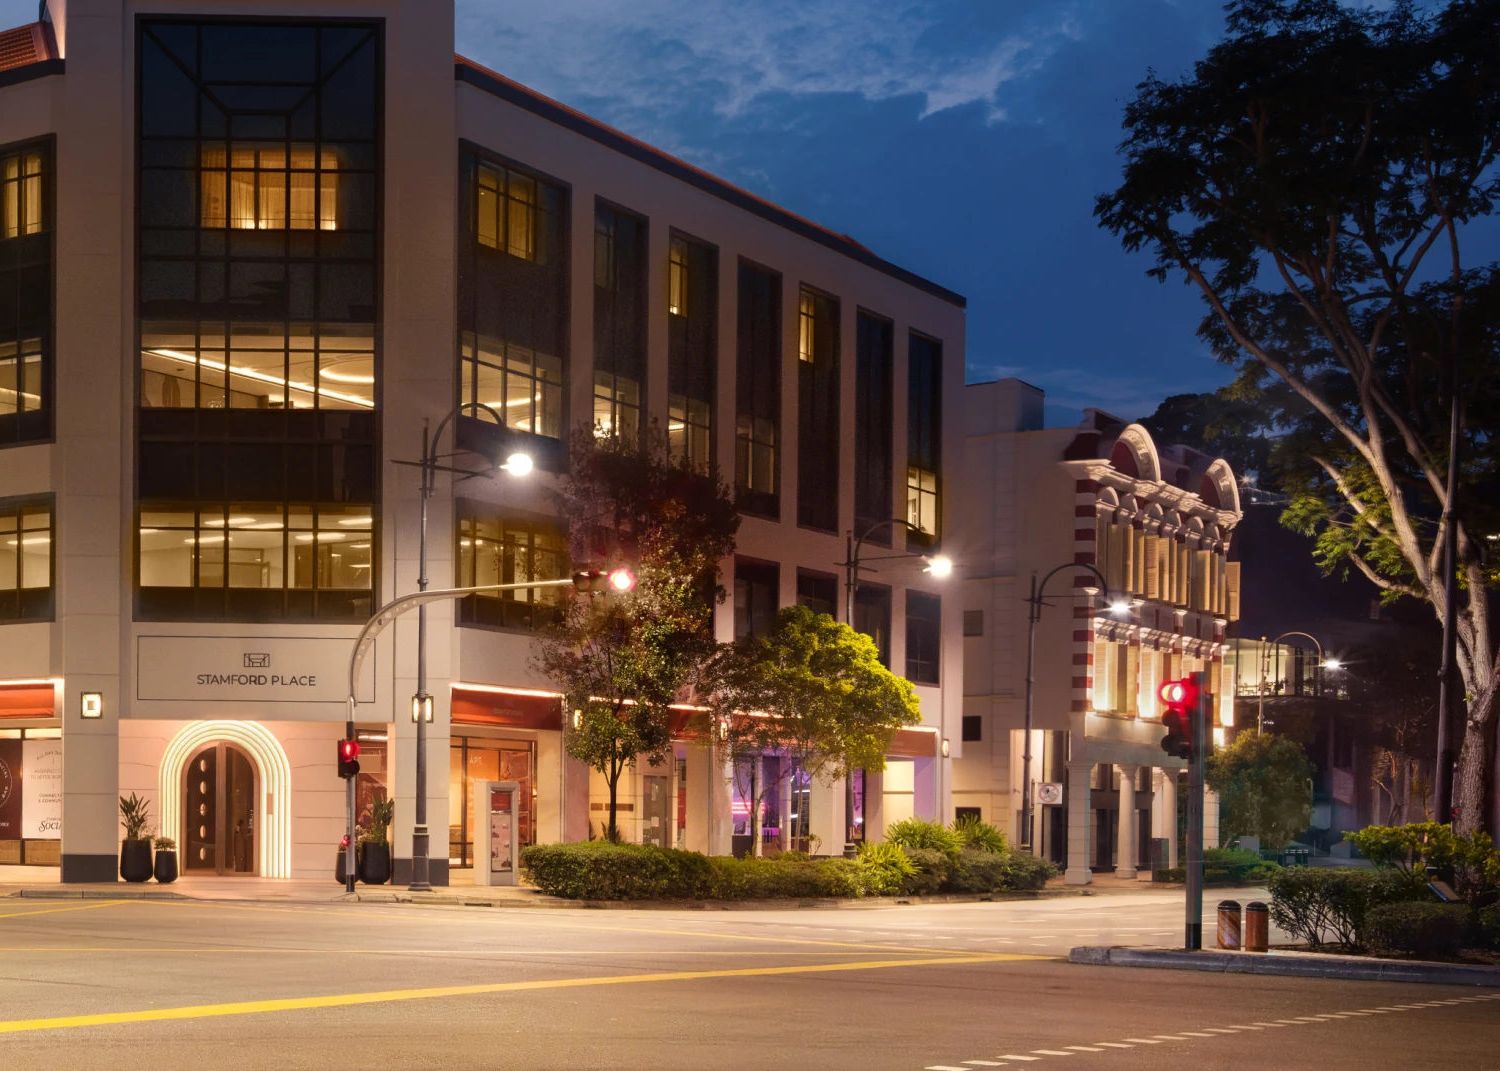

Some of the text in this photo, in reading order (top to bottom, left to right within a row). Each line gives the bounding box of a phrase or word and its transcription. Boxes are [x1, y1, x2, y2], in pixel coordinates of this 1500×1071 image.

[197, 674, 316, 687] STAMFORD PLACE
[1, 785, 9, 799] BAR
